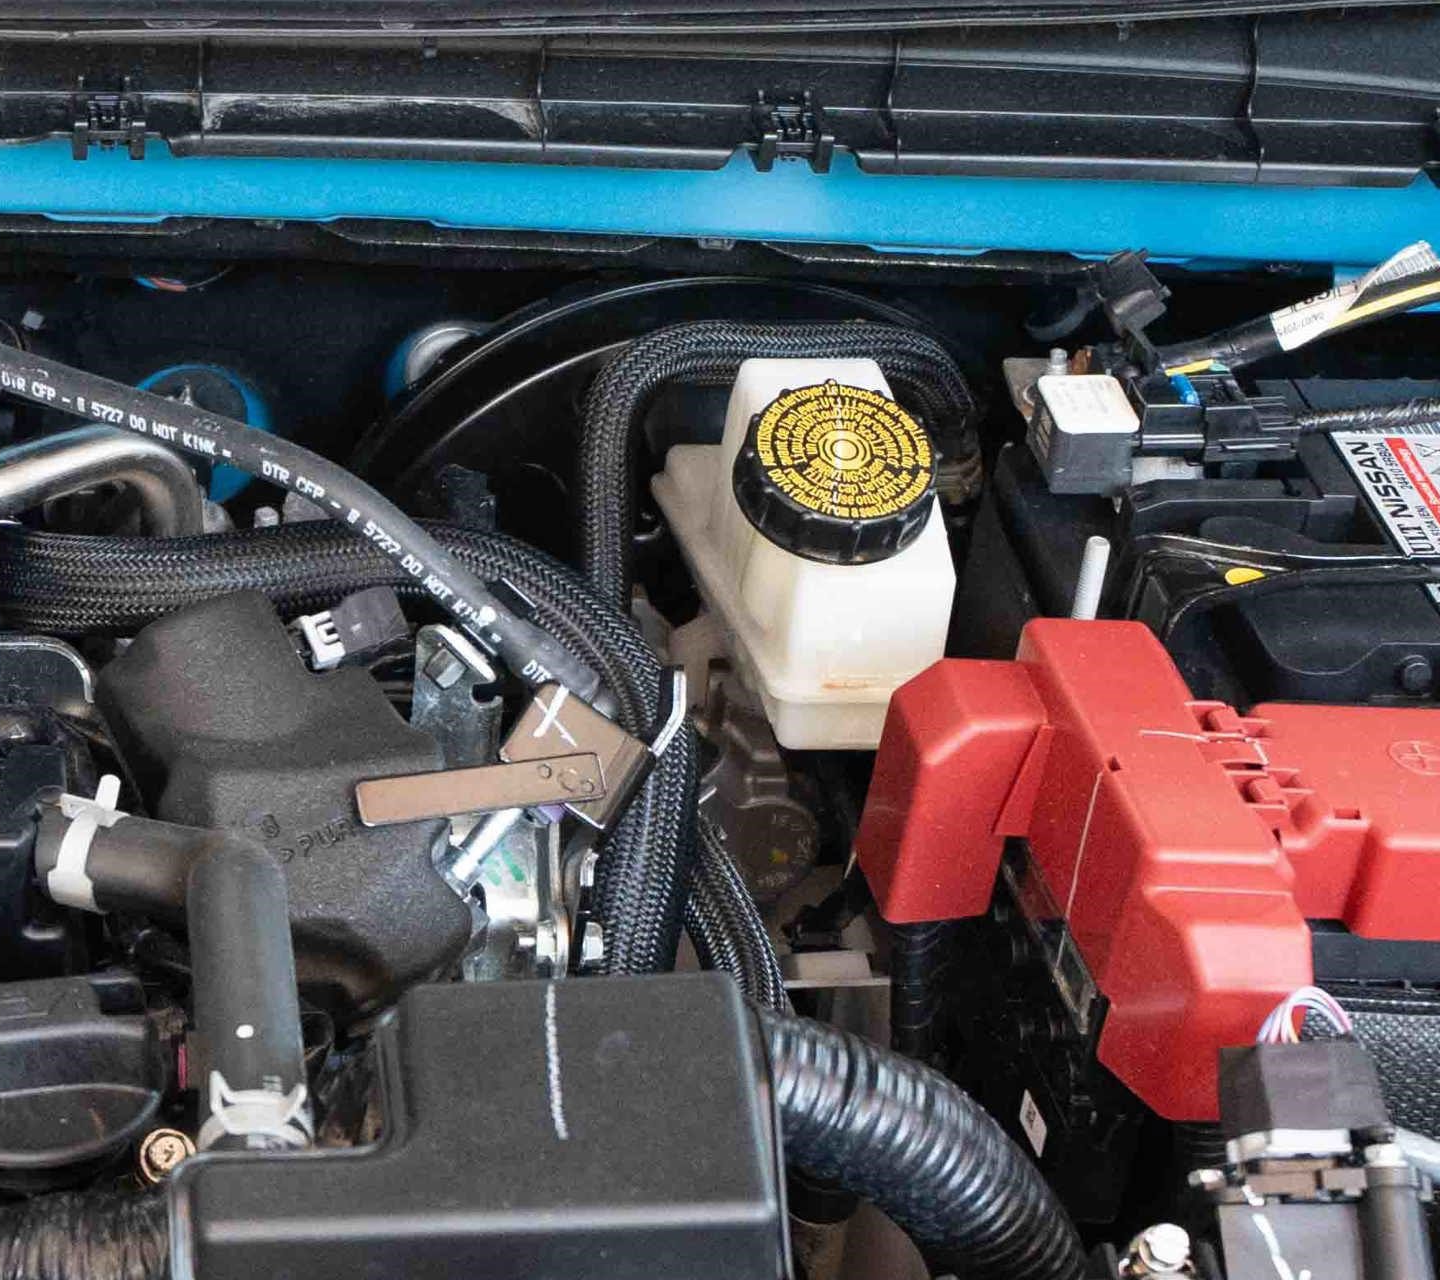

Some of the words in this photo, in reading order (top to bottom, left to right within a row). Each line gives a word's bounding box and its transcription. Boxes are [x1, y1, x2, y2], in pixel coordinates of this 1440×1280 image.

[31, 381, 57, 402] CFP
[91, 402, 124, 424] 5727
[129, 413, 147, 432] DO
[152, 421, 178, 441] NOT
[183, 431, 217, 456] KINK
[262, 460, 290, 485] DTR
[295, 477, 326, 500] CFP
[363, 521, 402, 555] 5727
[422, 574, 453, 606] NOT
[838, 483, 858, 495] cap
[1343, 440, 1415, 518] NISSAN
